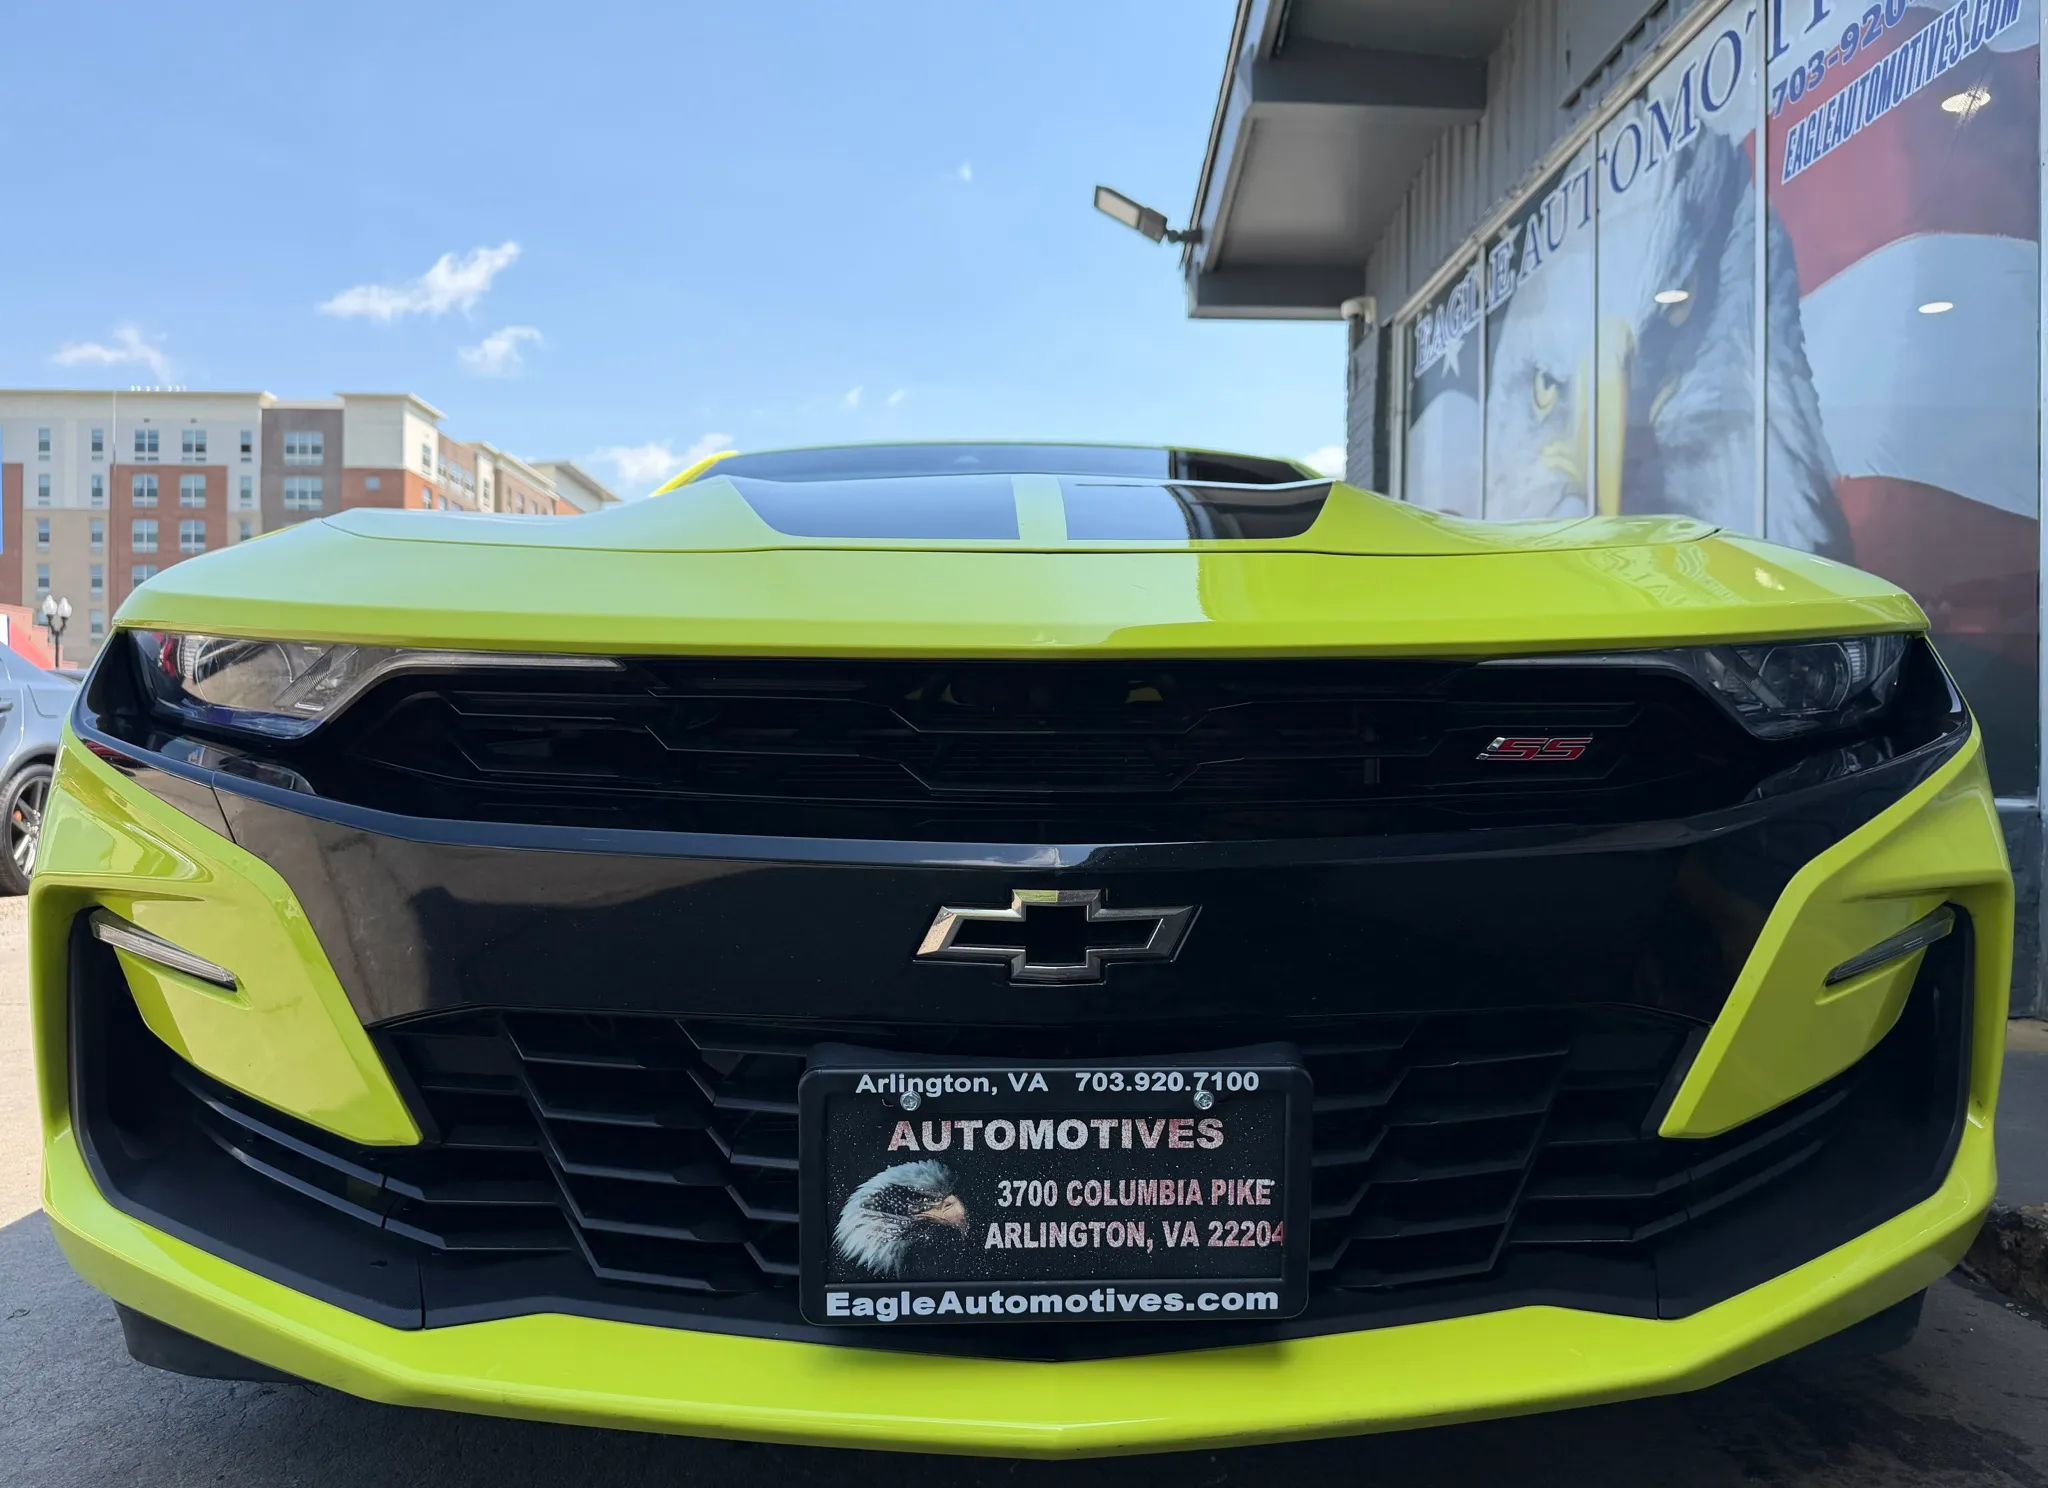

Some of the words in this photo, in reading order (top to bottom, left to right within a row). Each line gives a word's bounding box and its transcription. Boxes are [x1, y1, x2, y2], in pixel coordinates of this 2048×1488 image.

[1772, 0, 1910, 118] 703-920
[1415, 239, 1516, 376] EAGLE
[1518, 0, 1831, 283] AUTOMOT
[1476, 737, 1592, 760] SS
[856, 1073, 998, 1097] Arlington,
[1008, 1072, 1049, 1092] VA
[1075, 1071, 1260, 1092] 703.920.7100
[887, 1118, 1225, 1151] AUTOMOTIVES
[998, 1180, 1058, 1207] 3700
[1066, 1179, 1204, 1206] COLUMBIA
[1211, 1178, 1273, 1206] PIKE
[984, 1221, 1153, 1253] ARLINGTON,
[1162, 1220, 1200, 1247] VA
[1207, 1219, 1286, 1247] 22204
[826, 1288, 1279, 1322] EagleAutomotives.com
